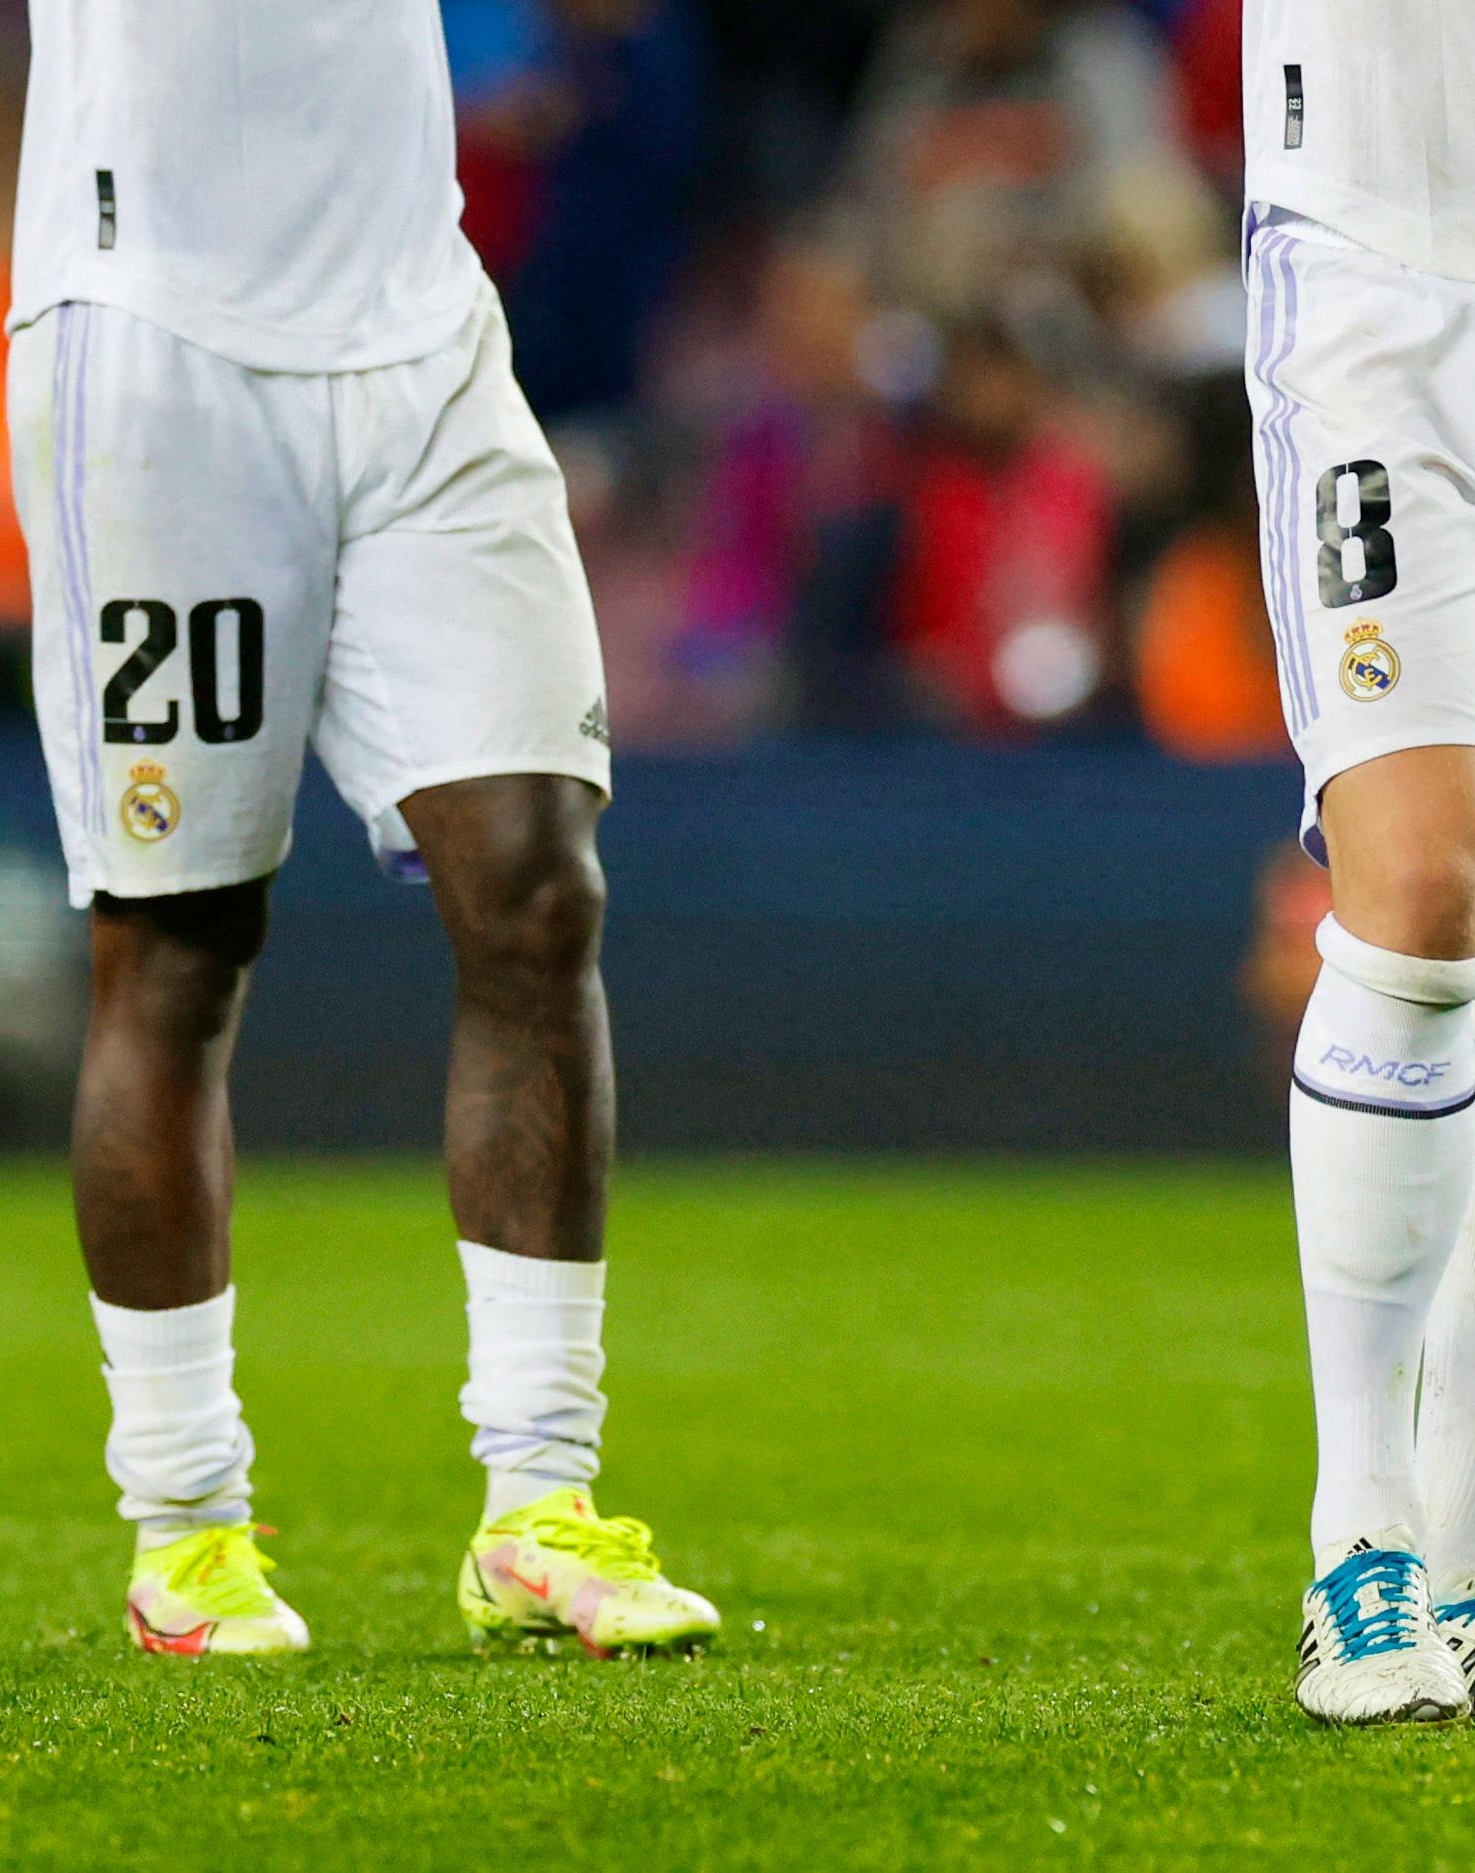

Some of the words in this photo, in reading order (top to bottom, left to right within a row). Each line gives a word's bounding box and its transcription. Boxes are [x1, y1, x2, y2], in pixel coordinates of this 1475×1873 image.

[1316, 459, 1397, 608] 8
[100, 597, 263, 744] 20
[1319, 1043, 1452, 1086] RMCF
